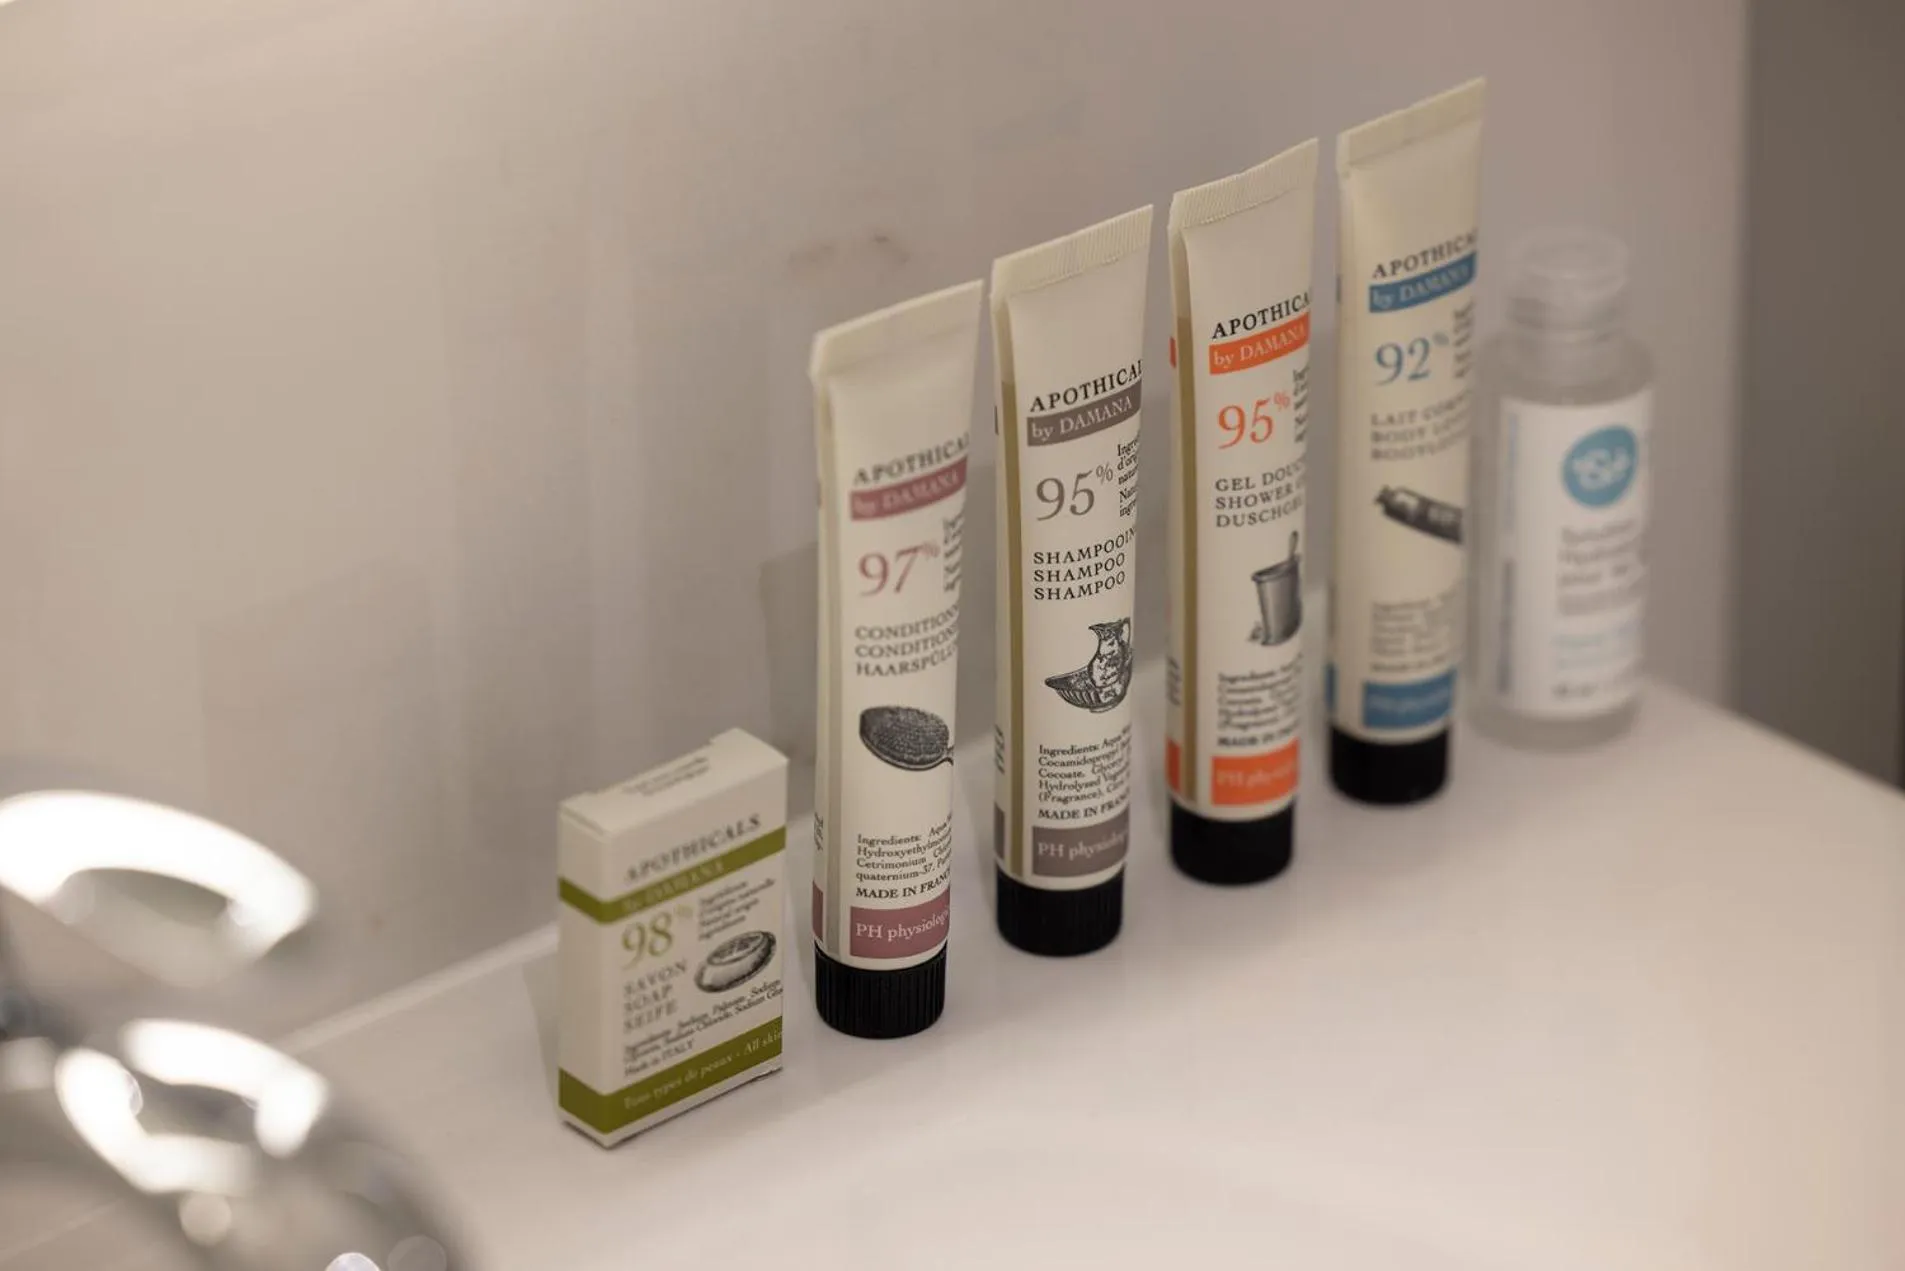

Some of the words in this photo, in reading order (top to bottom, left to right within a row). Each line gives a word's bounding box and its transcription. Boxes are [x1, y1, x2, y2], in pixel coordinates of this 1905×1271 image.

[1373, 289, 1394, 309] by
[1213, 351, 1234, 369] by
[1240, 323, 1305, 361] DAMANA
[1031, 422, 1054, 442] by
[1059, 395, 1132, 435] DAMANA
[1215, 477, 1256, 492] GEL
[1215, 484, 1293, 510] SHOWER
[1033, 552, 1125, 583] SHAMPOO
[1033, 570, 1125, 601] SHAMPOO
[1038, 809, 1080, 821] MADE
[1084, 807, 1098, 818] IN
[625, 814, 761, 885] APOTHICALS
[856, 857, 926, 870] Cetrimonium
[1038, 842, 1064, 857] PH
[856, 887, 898, 899] MADE
[902, 886, 917, 898] IN
[856, 923, 882, 938] PH
[624, 959, 687, 996] SAVON
[624, 983, 673, 1015] SOAP
[624, 999, 678, 1033] SEIFE
[684, 1066, 699, 1082] de
[699, 1054, 734, 1080] peaux
[743, 1036, 761, 1056] All
